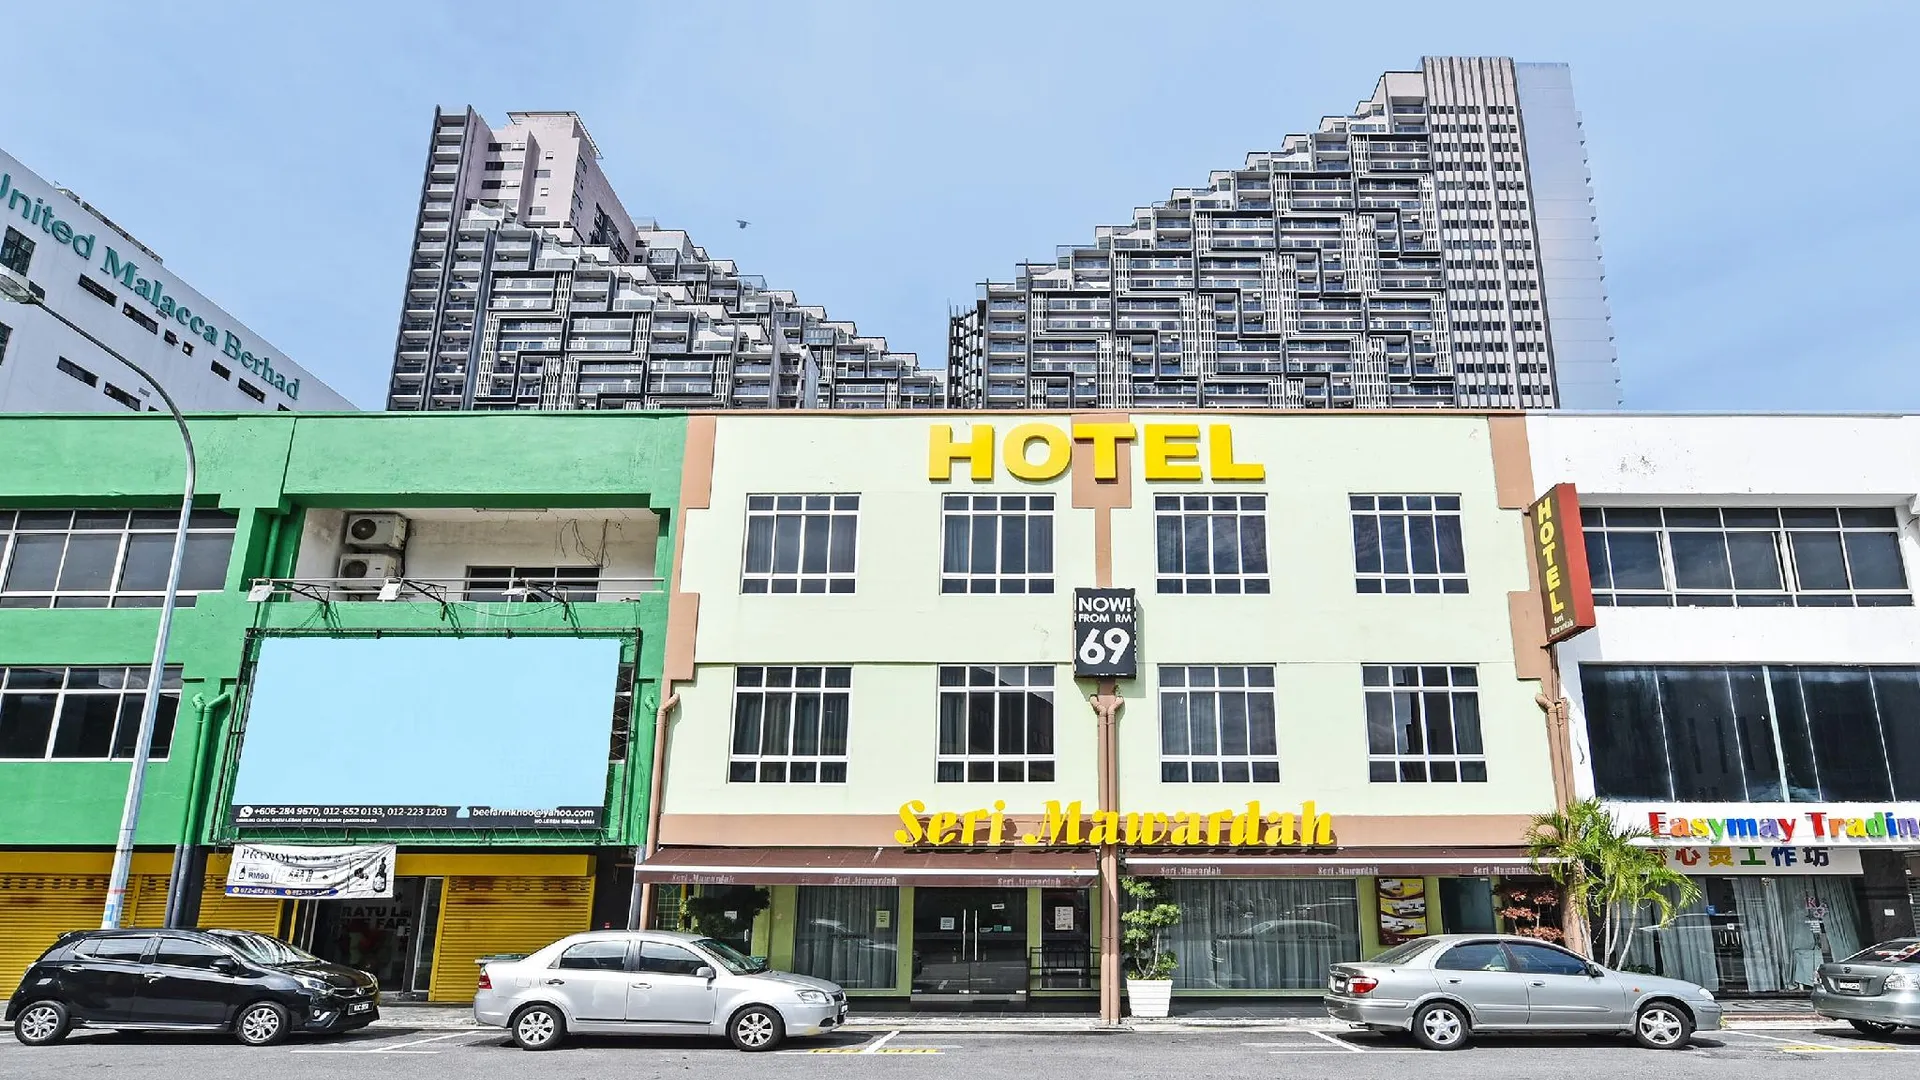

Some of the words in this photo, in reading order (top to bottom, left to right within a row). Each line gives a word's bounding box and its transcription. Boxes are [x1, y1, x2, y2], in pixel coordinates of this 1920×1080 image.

[100, 246, 219, 347] Malacca
[221, 329, 301, 401] Berhad
[929, 423, 1265, 483] HOTEL
[1537, 496, 1564, 614] HOTEL
[1078, 597, 1131, 612] NOW!
[1078, 613, 1110, 623] FROM
[1115, 613, 1132, 623] RM
[1079, 627, 1130, 665] 69
[387, 807, 424, 816] 012-223
[425, 807, 447, 816] 1203
[894, 799, 1009, 846] Seri
[1022, 799, 1334, 846] Mawardah
[1648, 812, 1796, 844] Easymay
[1804, 812, 1920, 839] Tradin
[248, 871, 270, 880] RM90
